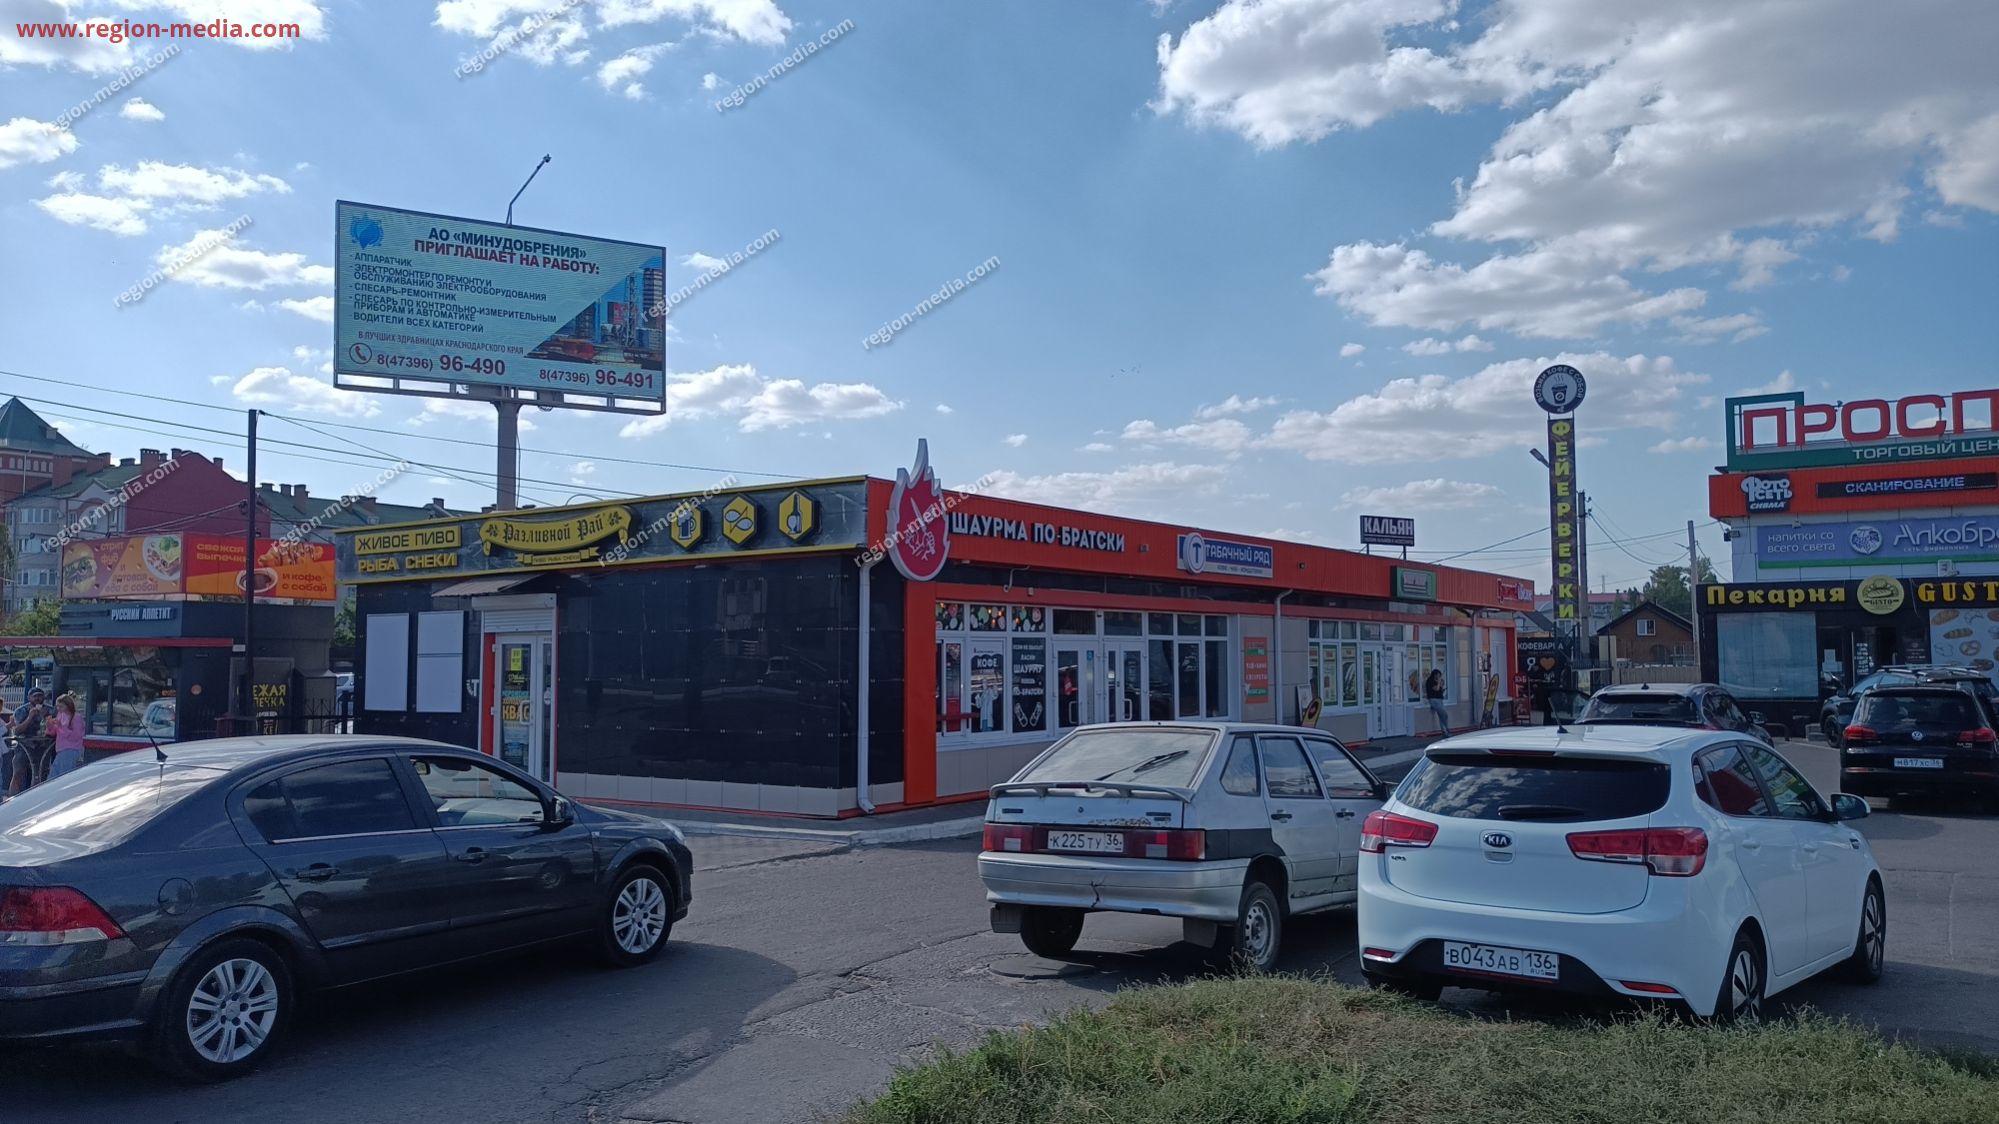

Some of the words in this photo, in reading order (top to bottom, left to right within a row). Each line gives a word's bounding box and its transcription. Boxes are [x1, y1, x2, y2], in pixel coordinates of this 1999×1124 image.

[429, 227, 450, 241] АО
[454, 231, 586, 258] «МИНУДОБРЕНИЯ»
[354, 252, 412, 267] АППАРАТЧИК
[414, 240, 516, 264] ПРИГЛАШАЕТ
[520, 254, 539, 267] НА
[543, 257, 600, 275] РАБОТУ:
[354, 263, 430, 279] ЭЛЕКТРОМОНТЕР
[431, 272, 444, 281] ПО
[445, 273, 485, 286] РЕМОНТУ
[354, 271, 434, 289] ОБСЛУЖИВАНИЮ
[436, 280, 547, 301] ЭЛЕКТРООБОРУДОВАНИЯ
[354, 282, 457, 301] СЛЕСАРЬ-РЕМОНТНИК
[354, 293, 398, 306] СЛЕСАРЬ
[400, 298, 414, 308] ПО
[416, 300, 557, 323] КОНТРОЛЬНО-ИЗМЕРИТЕЛЬНЫМ
[354, 301, 405, 315] ПРИБОРАМ
[407, 307, 414, 315] И
[416, 306, 476, 322] АВТОМАТИКЕ
[353, 312, 404, 325] ВОДИТЕЛИ
[406, 318, 430, 328] ВСЕХ
[432, 318, 484, 333] КАТЕГОРИЙ
[358, 331, 363, 339] В
[364, 332, 396, 342] ЛУЧШИХ
[397, 334, 444, 347] ЗДРАВНИЦАХ
[445, 340, 505, 353] КРАСНОДАРСКОГО
[507, 346, 524, 355] КРАЯ
[377, 353, 433, 371] 8(47396)
[439, 354, 506, 376] 96-490
[540, 369, 590, 385] 8(47396)
[595, 369, 653, 389] 96-491
[1852, 438, 1957, 460] ТОРГОВЫЙ
[1741, 476, 1790, 501] ФОТО
[1755, 488, 1793, 501] СЕТЬ
[1845, 476, 1965, 493] СКАНИРОВАНИЕ
[504, 522, 571, 544] Разливной
[577, 515, 604, 539] Рай
[1364, 517, 1414, 536] КАЛЬЯН
[1551, 421, 1574, 619] ФЕЙЕРВЕРКИ
[357, 533, 410, 551] ЖИВОЕ
[414, 529, 456, 546] ПИВО
[952, 511, 1027, 541] ШАУРМА
[1034, 522, 1125, 552] ПО-БРАТСКИ
[1767, 531, 1817, 543] напитки
[1820, 531, 1835, 540] со
[196, 543, 244, 553] свежая
[1204, 544, 1252, 562] ТАБАЧНЫЙ
[1253, 551, 1271, 566] РЯД
[1766, 542, 1799, 554] всего
[1802, 541, 1836, 552] света
[357, 556, 400, 573] РЫБА
[405, 552, 458, 569] СНЕКИ
[289, 573, 321, 581] кофе
[291, 582, 327, 592] собой
[1707, 585, 1845, 608] Пекарня
[1917, 581, 1999, 603] GUST
[111, 604, 140, 620] РУССКИЙ
[142, 607, 172, 620] АППЕТИТ
[1517, 641, 1564, 650] КОФЕВАРА
[976, 658, 998, 668] КОФЕ
[1013, 663, 1044, 674] ШАУРМУ
[252, 683, 287, 697] ЕЖАЯ
[1053, 832, 1101, 848] К225ТУ
[1106, 833, 1120, 847] 36
[1488, 837, 1508, 848] KIA
[1449, 946, 1520, 971] В043АВ
[1524, 952, 1552, 970] 136
